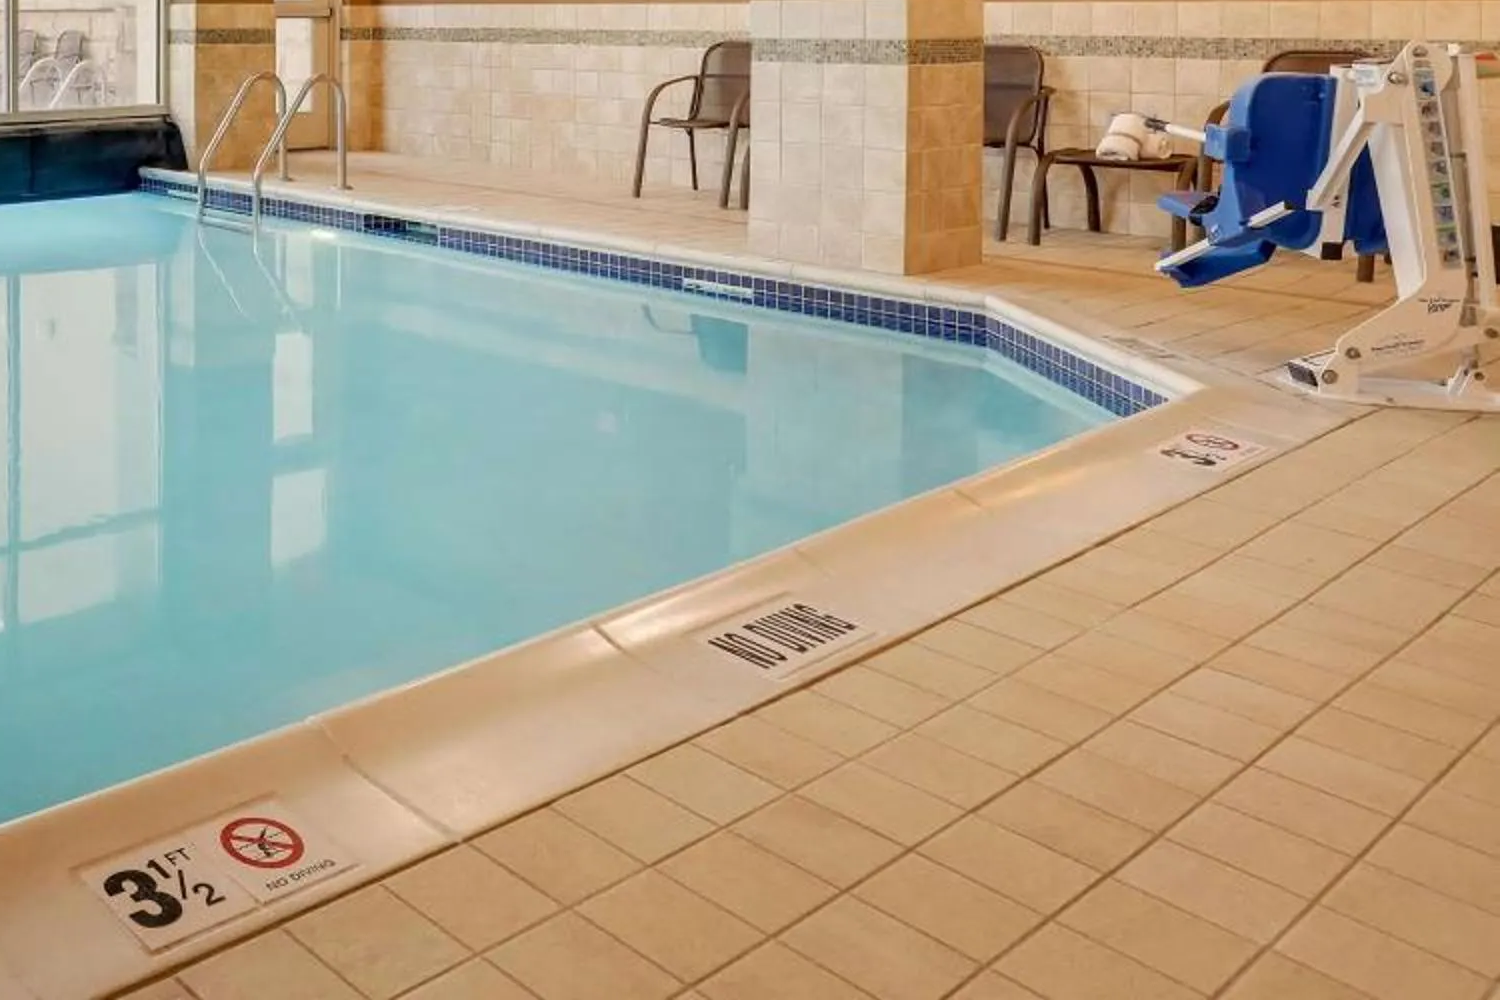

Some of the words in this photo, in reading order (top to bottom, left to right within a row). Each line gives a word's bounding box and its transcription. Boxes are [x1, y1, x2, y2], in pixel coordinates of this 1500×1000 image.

[742, 603, 858, 654] DIVING
[707, 632, 789, 670] NO
[163, 847, 192, 868] FT
[265, 875, 290, 893] NO
[289, 858, 336, 881] DIVING
